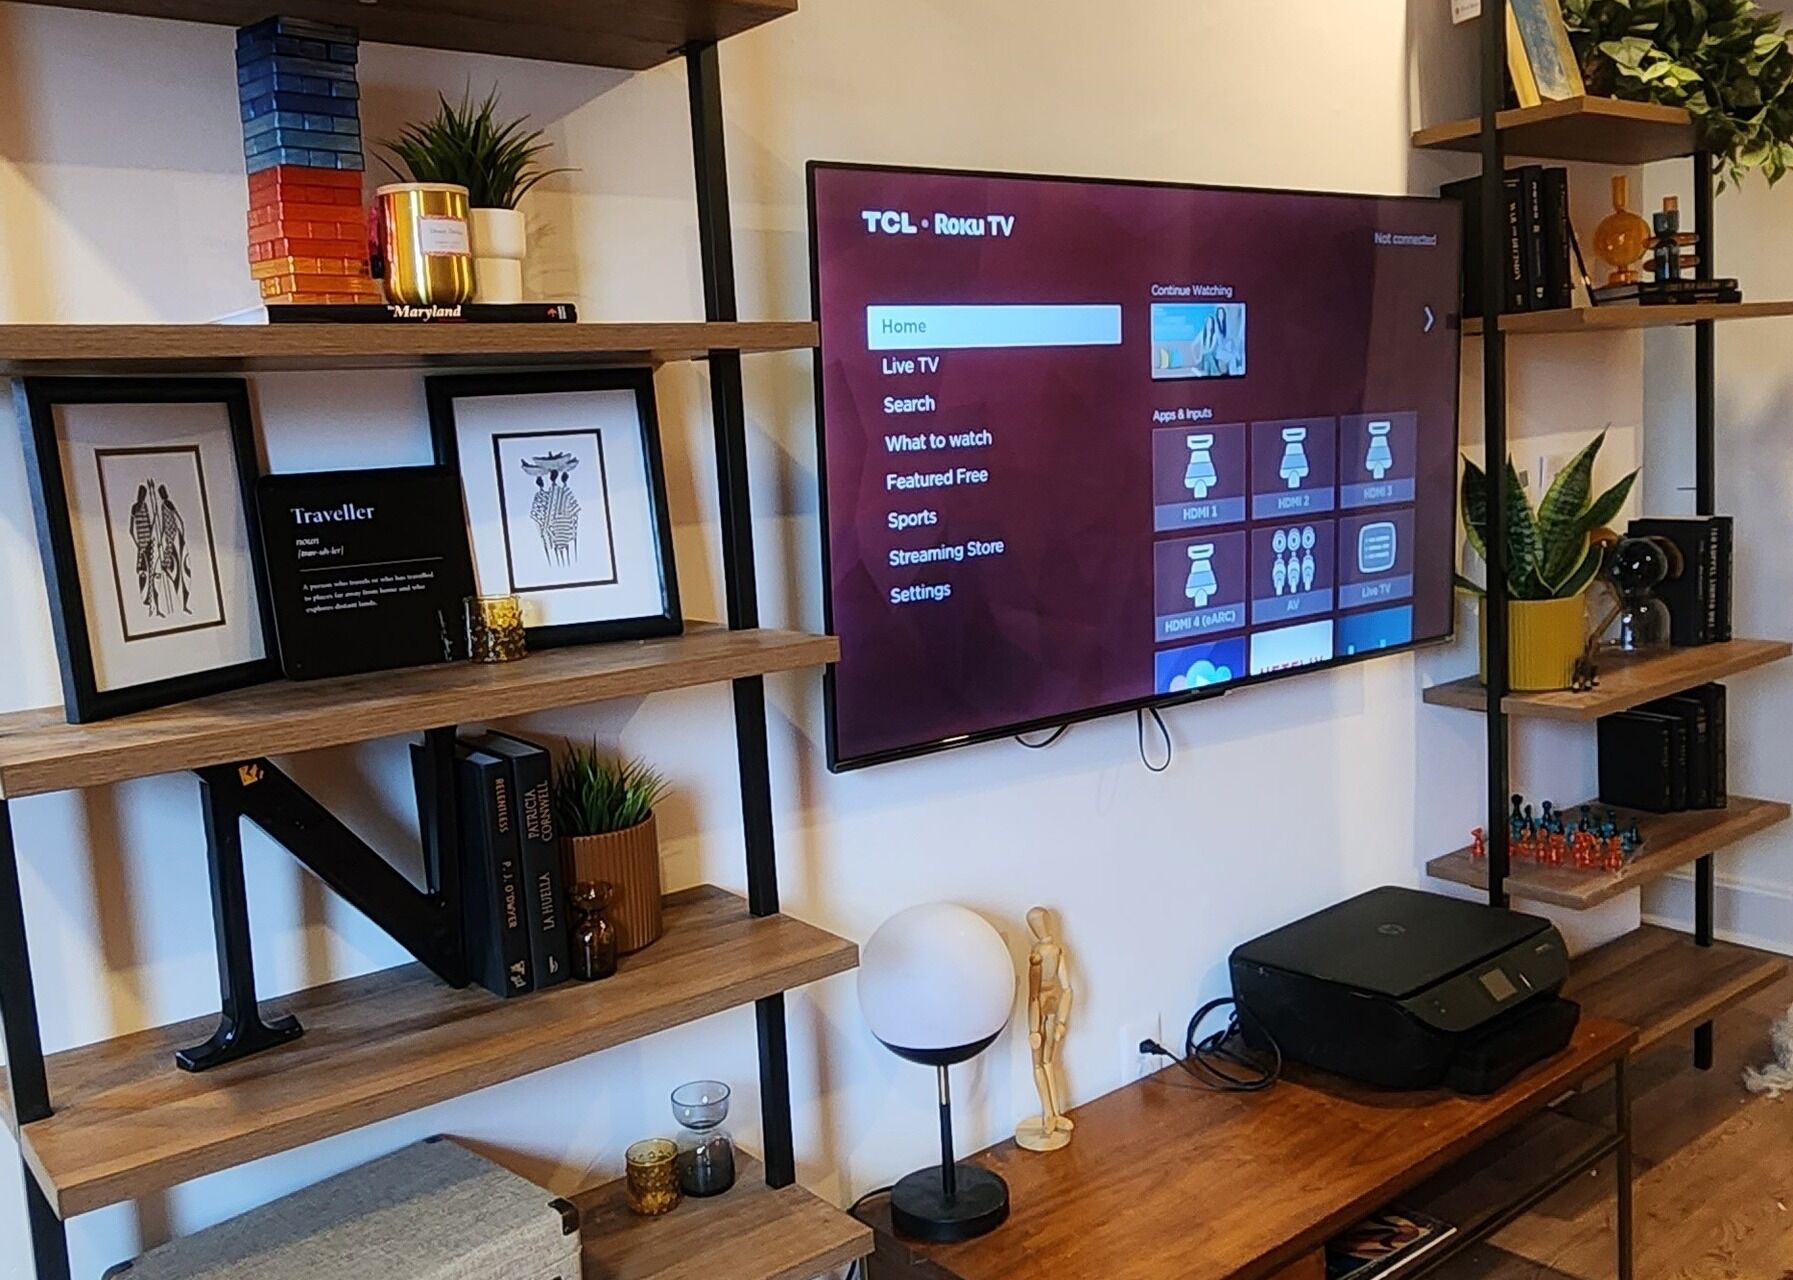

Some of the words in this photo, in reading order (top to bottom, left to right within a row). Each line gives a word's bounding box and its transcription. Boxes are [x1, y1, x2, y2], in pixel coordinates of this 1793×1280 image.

[861, 210, 918, 234] TCL
[987, 215, 1015, 237] TV
[1374, 232, 1392, 245] Not
[1393, 233, 1437, 246] connected
[1151, 284, 1190, 296] Continue
[1192, 284, 1233, 298] Watching
[393, 304, 462, 321] Maryland
[882, 319, 927, 334] Home
[882, 357, 914, 375] Live
[917, 357, 939, 373] TV
[883, 395, 936, 413] Search
[1153, 409, 1176, 423] Apps
[1178, 409, 1185, 419] &
[1186, 407, 1213, 421] Inputs
[885, 433, 926, 452] What
[930, 433, 946, 449] to
[949, 429, 993, 448] watch
[886, 469, 953, 491] Featured
[956, 468, 989, 485] Free
[1363, 487, 1386, 499] HDMI
[1387, 486, 1393, 497] 3
[1278, 497, 1302, 509] HDMI
[1304, 495, 1310, 506] 2
[290, 503, 375, 524] Traveller
[888, 509, 938, 530] Sports
[1183, 507, 1211, 521] HDMI
[1212, 506, 1218, 518] 1
[296, 537, 319, 546] noun
[889, 544, 964, 566] Streaming
[967, 540, 1005, 556] Store
[890, 583, 951, 604] Settings
[1361, 586, 1375, 598] Live
[1376, 583, 1392, 595] TV
[1286, 599, 1300, 611] AV
[1165, 617, 1192, 633] HDMI
[1193, 616, 1200, 628] 4
[1202, 610, 1236, 629] (eARC)
[495, 778, 509, 833] RELENTLESS
[524, 788, 539, 839] PATRICIA
[538, 780, 553, 842] CORNWELL
[539, 872, 554, 914] HUELLA
[505, 885, 518, 929] O'DWYER
[543, 917, 555, 931] LA
